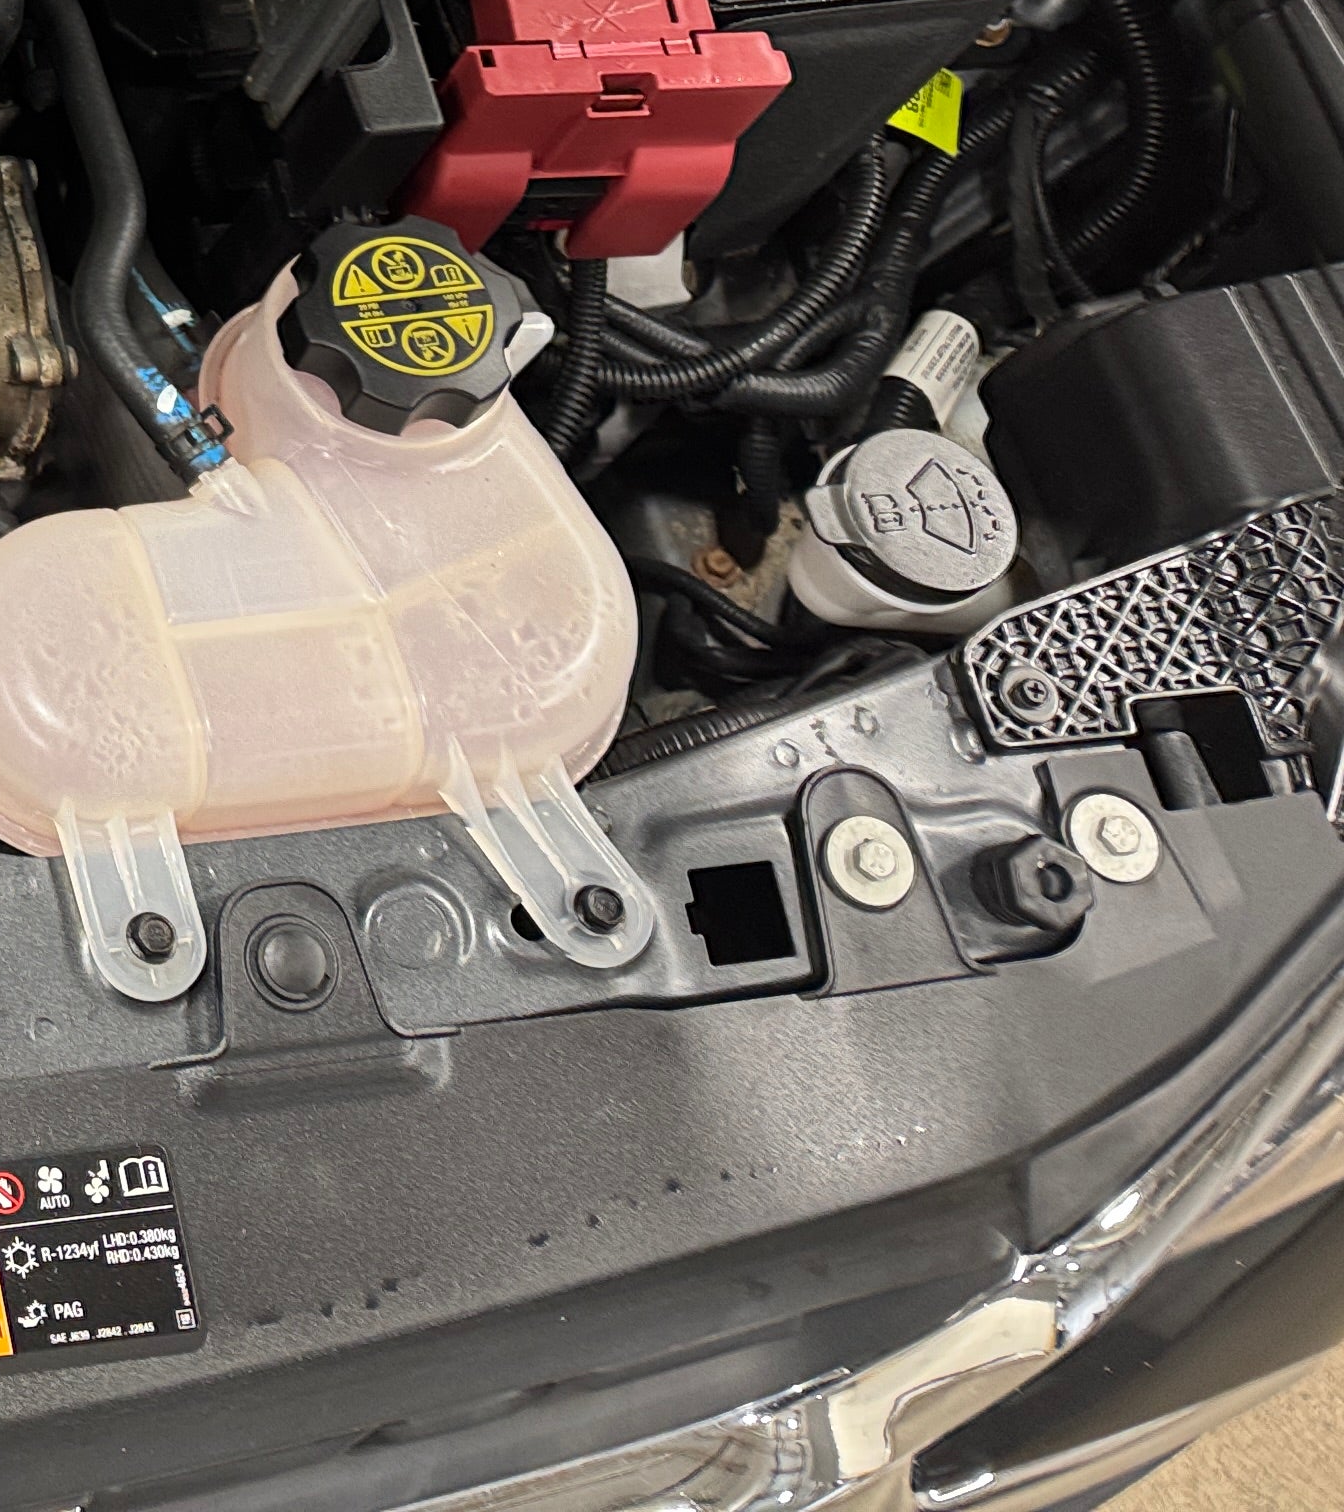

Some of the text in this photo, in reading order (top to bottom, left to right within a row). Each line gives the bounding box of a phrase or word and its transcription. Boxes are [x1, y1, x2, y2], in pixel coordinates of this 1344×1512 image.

[40, 1194, 71, 1210] AUTO
[41, 1228, 176, 1262] R-1234yf LHD:0.380kg
[106, 1245, 180, 1265] RHD:0.430kg
[53, 1301, 84, 1320] PAG
[50, 1333, 67, 1344] SAE
